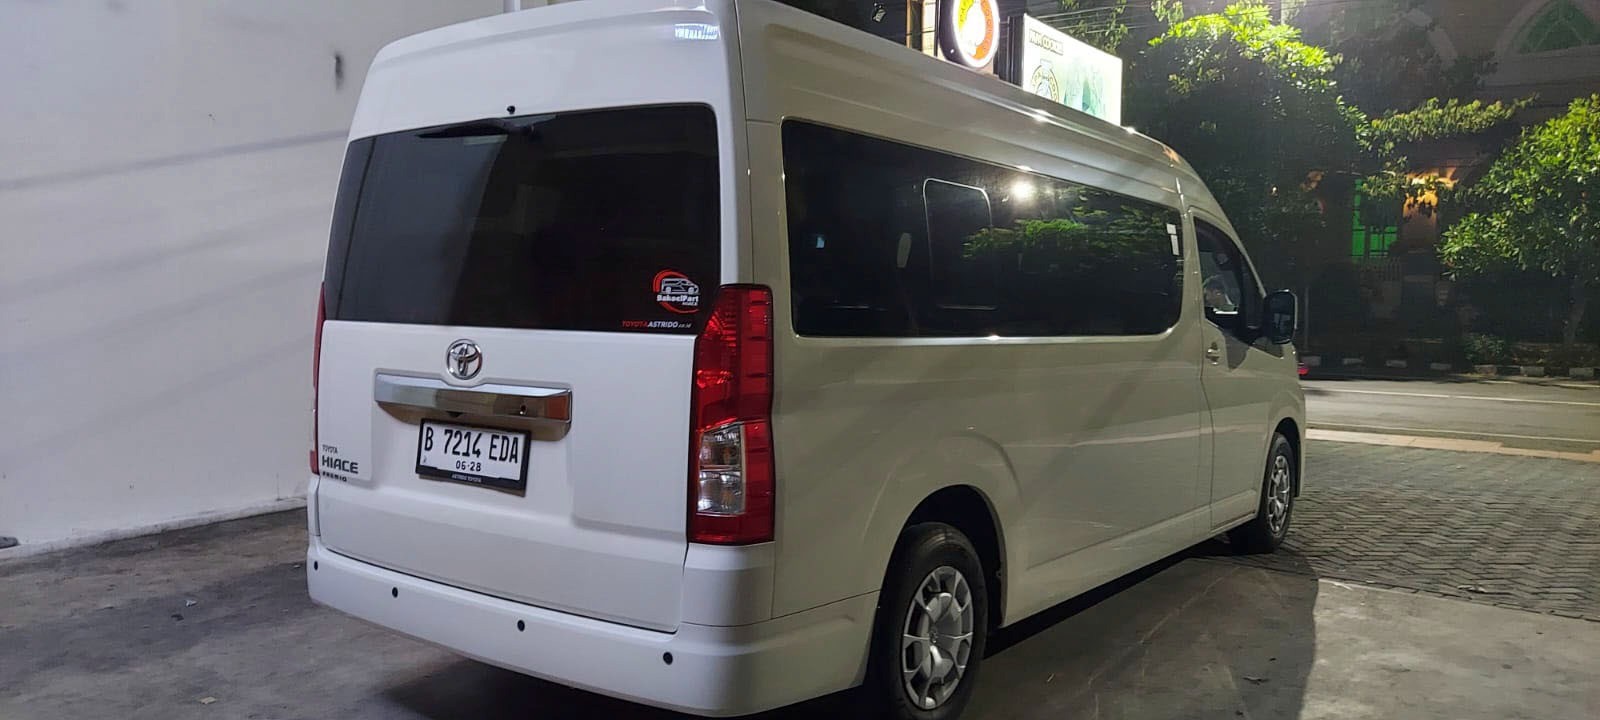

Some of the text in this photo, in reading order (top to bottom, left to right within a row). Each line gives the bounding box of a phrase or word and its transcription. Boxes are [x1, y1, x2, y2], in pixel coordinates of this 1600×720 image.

[424, 426, 519, 464] B 7214 EDA
[322, 455, 359, 475] HIACE
